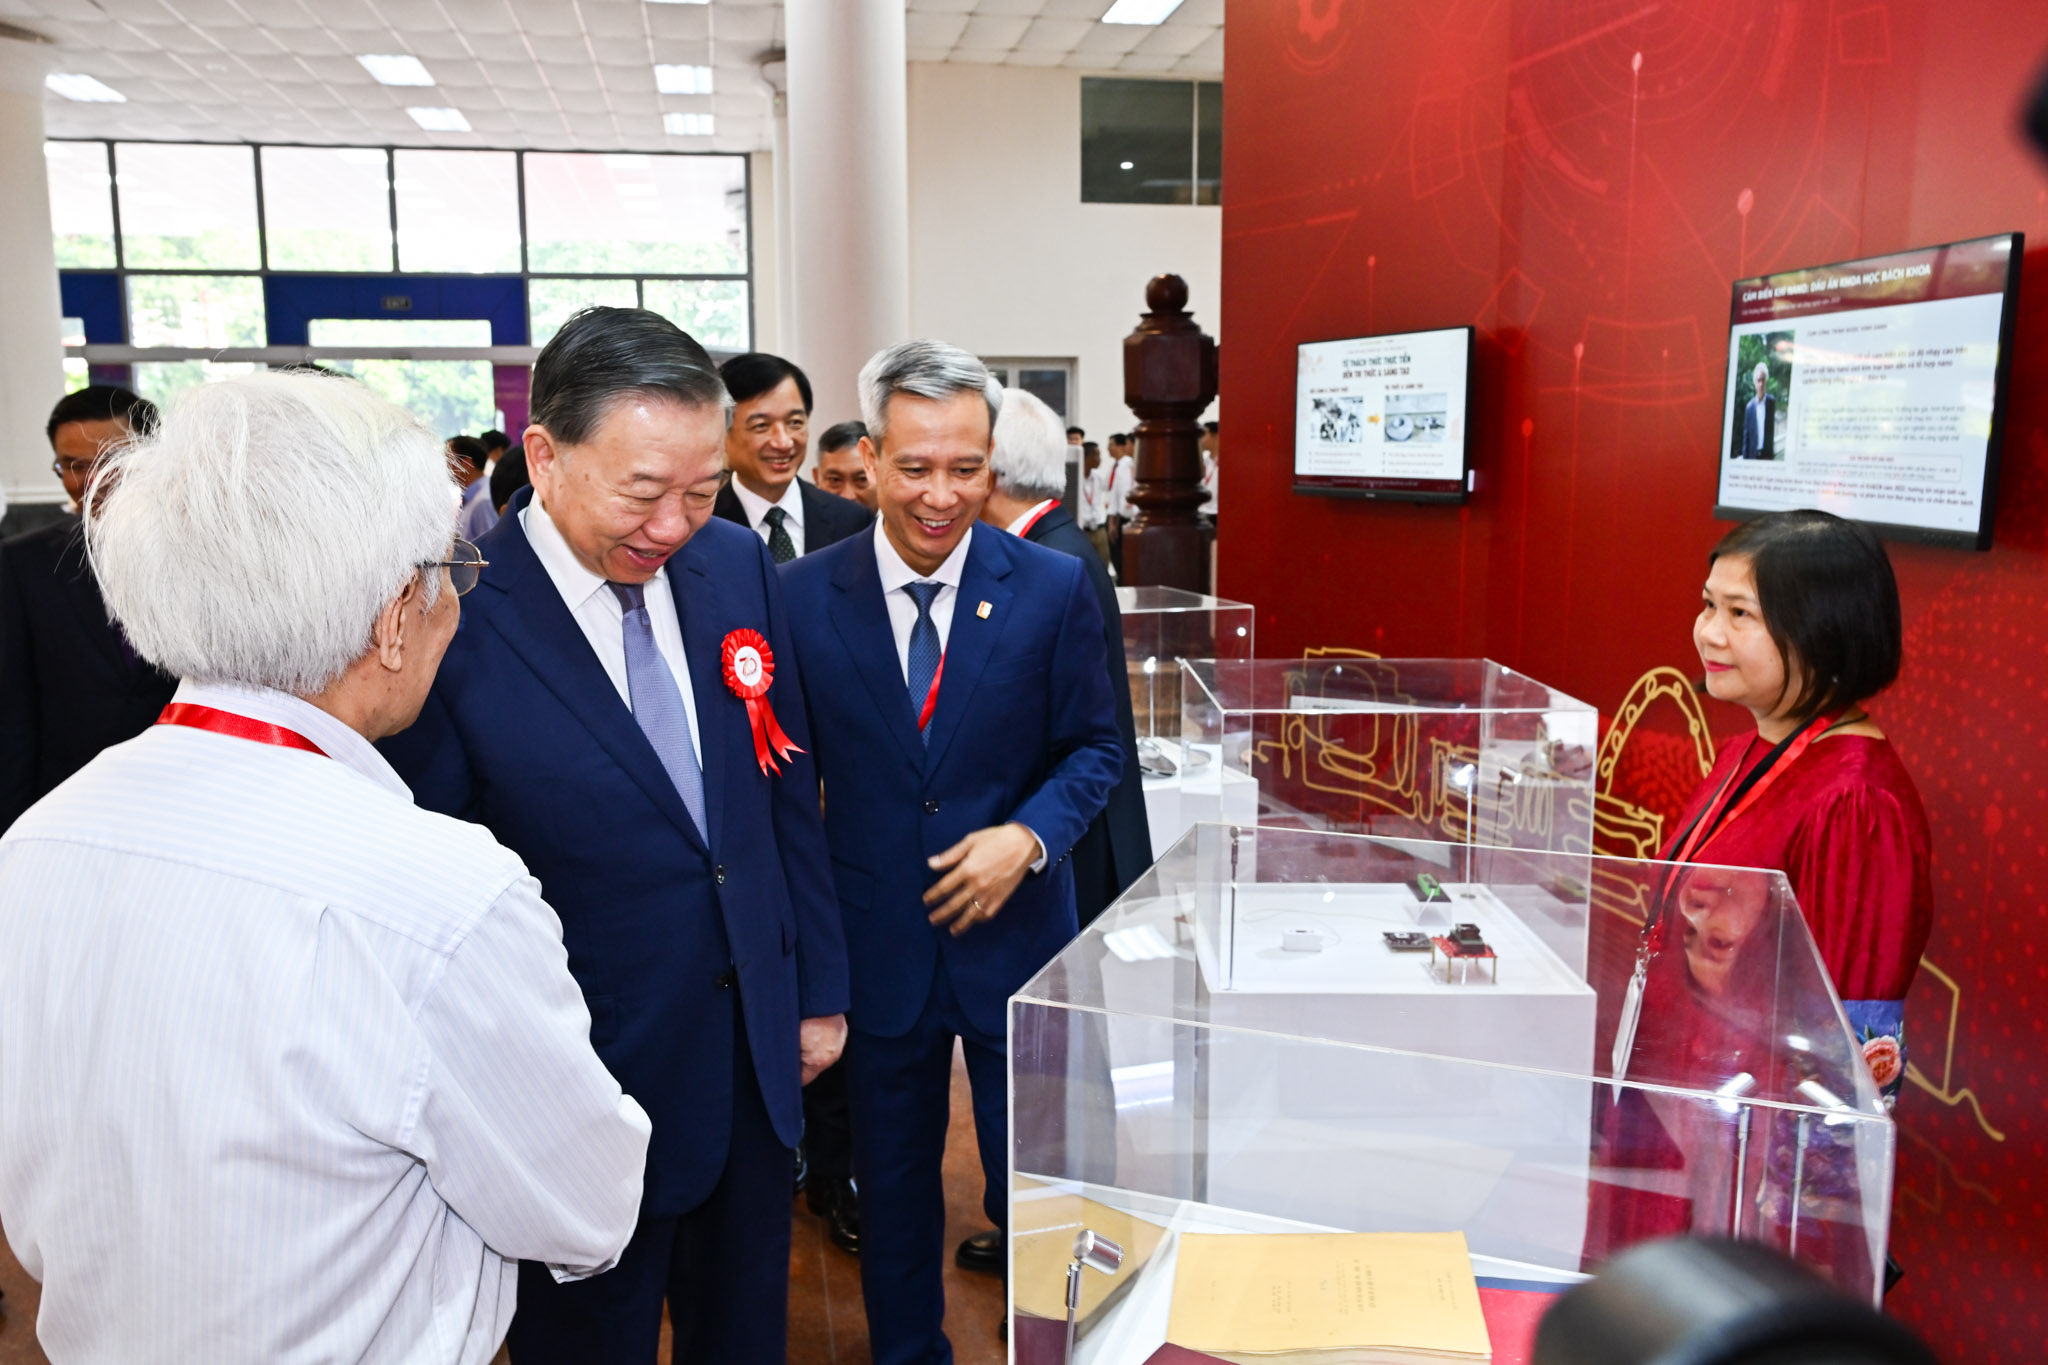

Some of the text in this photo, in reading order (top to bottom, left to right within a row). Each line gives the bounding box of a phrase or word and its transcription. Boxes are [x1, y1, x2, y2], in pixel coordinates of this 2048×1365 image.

[1839, 275, 1861, 288] KHOA
[1862, 271, 1880, 286] HỌC
[1881, 267, 1904, 282] BÁCH
[1905, 263, 1931, 278] KHOA
